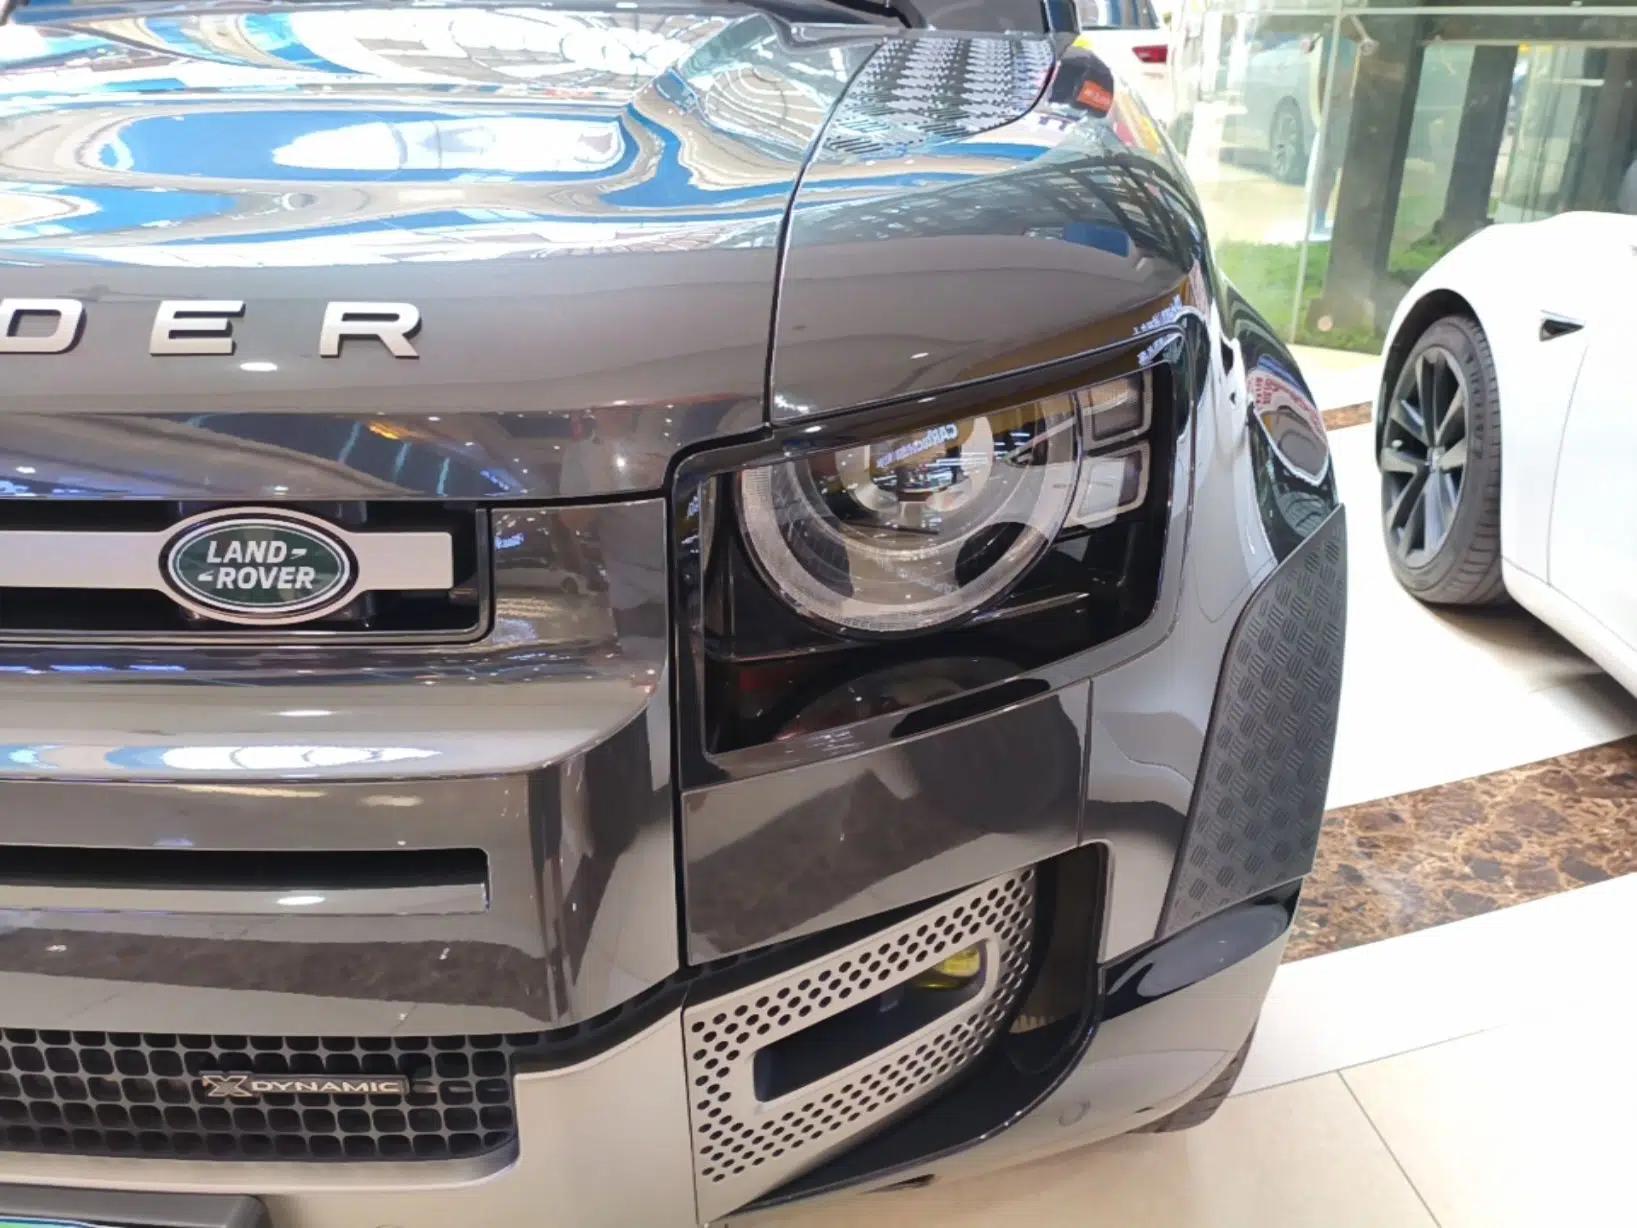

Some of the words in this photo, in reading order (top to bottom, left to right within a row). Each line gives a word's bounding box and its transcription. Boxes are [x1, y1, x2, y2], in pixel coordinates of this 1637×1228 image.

[0, 298, 421, 358] DER
[206, 540, 288, 564] LAND
[216, 566, 316, 590] ROVER
[251, 1080, 400, 1093] DYNAMIC
